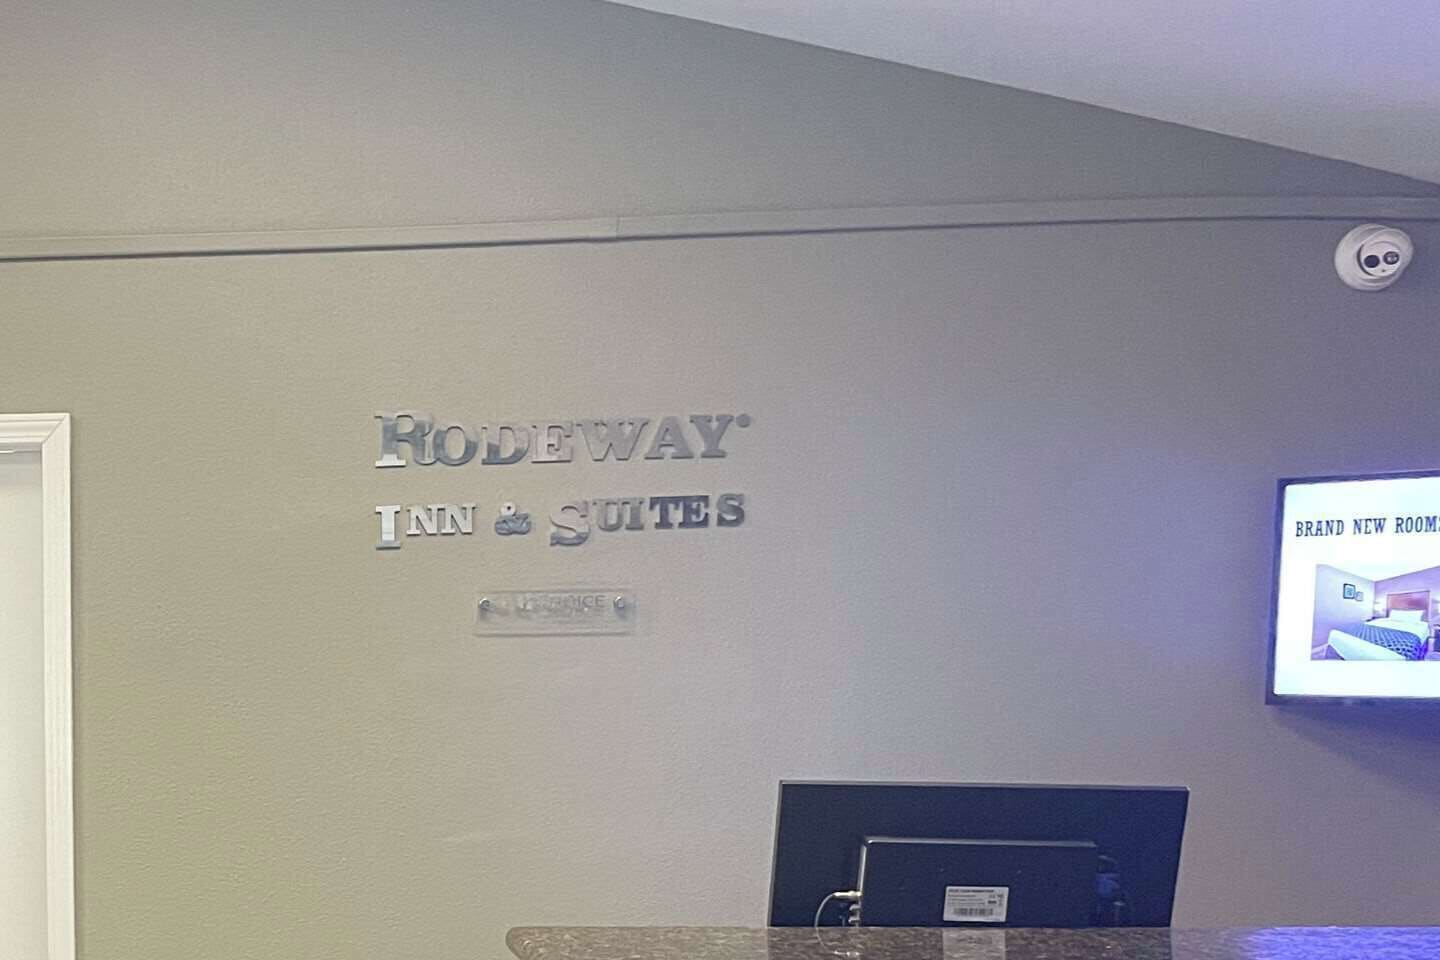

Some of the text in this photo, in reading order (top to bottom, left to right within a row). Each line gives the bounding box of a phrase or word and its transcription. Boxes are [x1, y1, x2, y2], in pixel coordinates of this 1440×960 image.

[374, 411, 735, 468] RODEWAY
[375, 493, 746, 550] INN & SUITES
[1295, 515, 1440, 537] BRAND NEW ROOM
